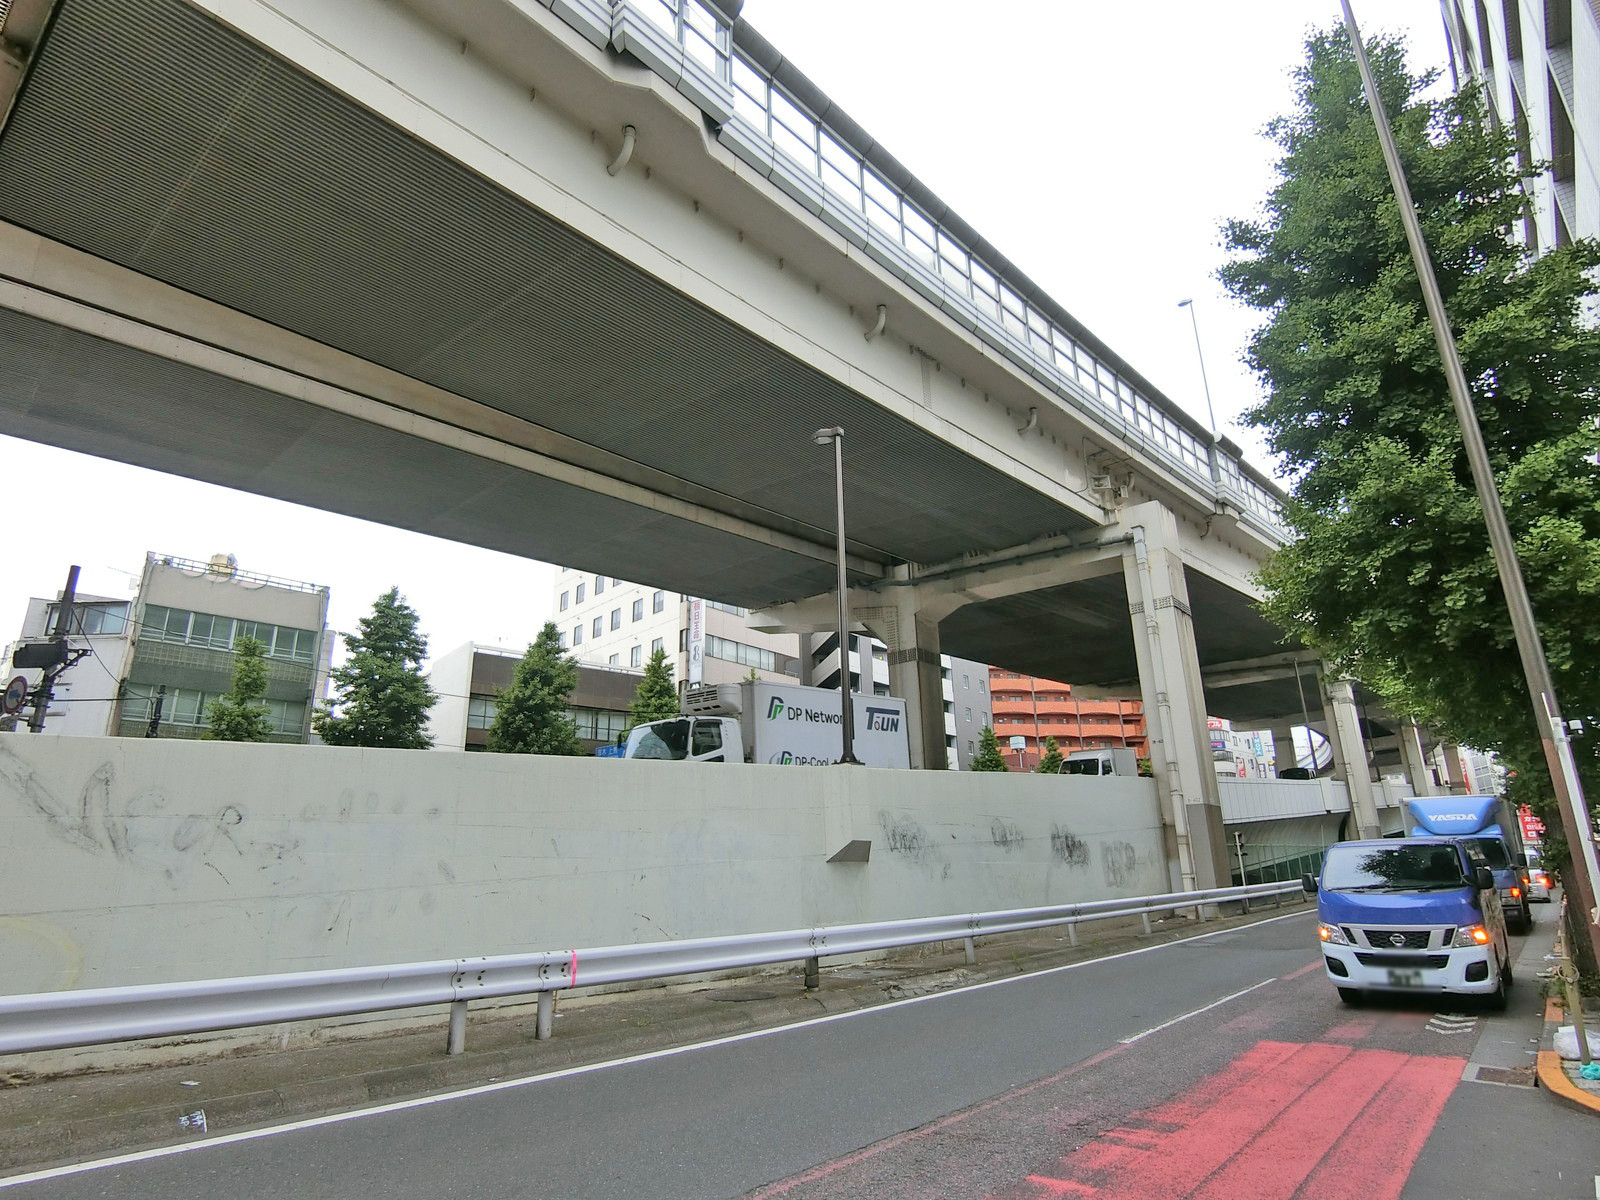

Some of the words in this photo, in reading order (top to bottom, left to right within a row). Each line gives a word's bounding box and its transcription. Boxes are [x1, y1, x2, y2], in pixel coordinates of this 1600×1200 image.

[787, 706, 802, 721] DP
[805, 709, 843, 724] Networ
[1428, 813, 1478, 822] YASDA
